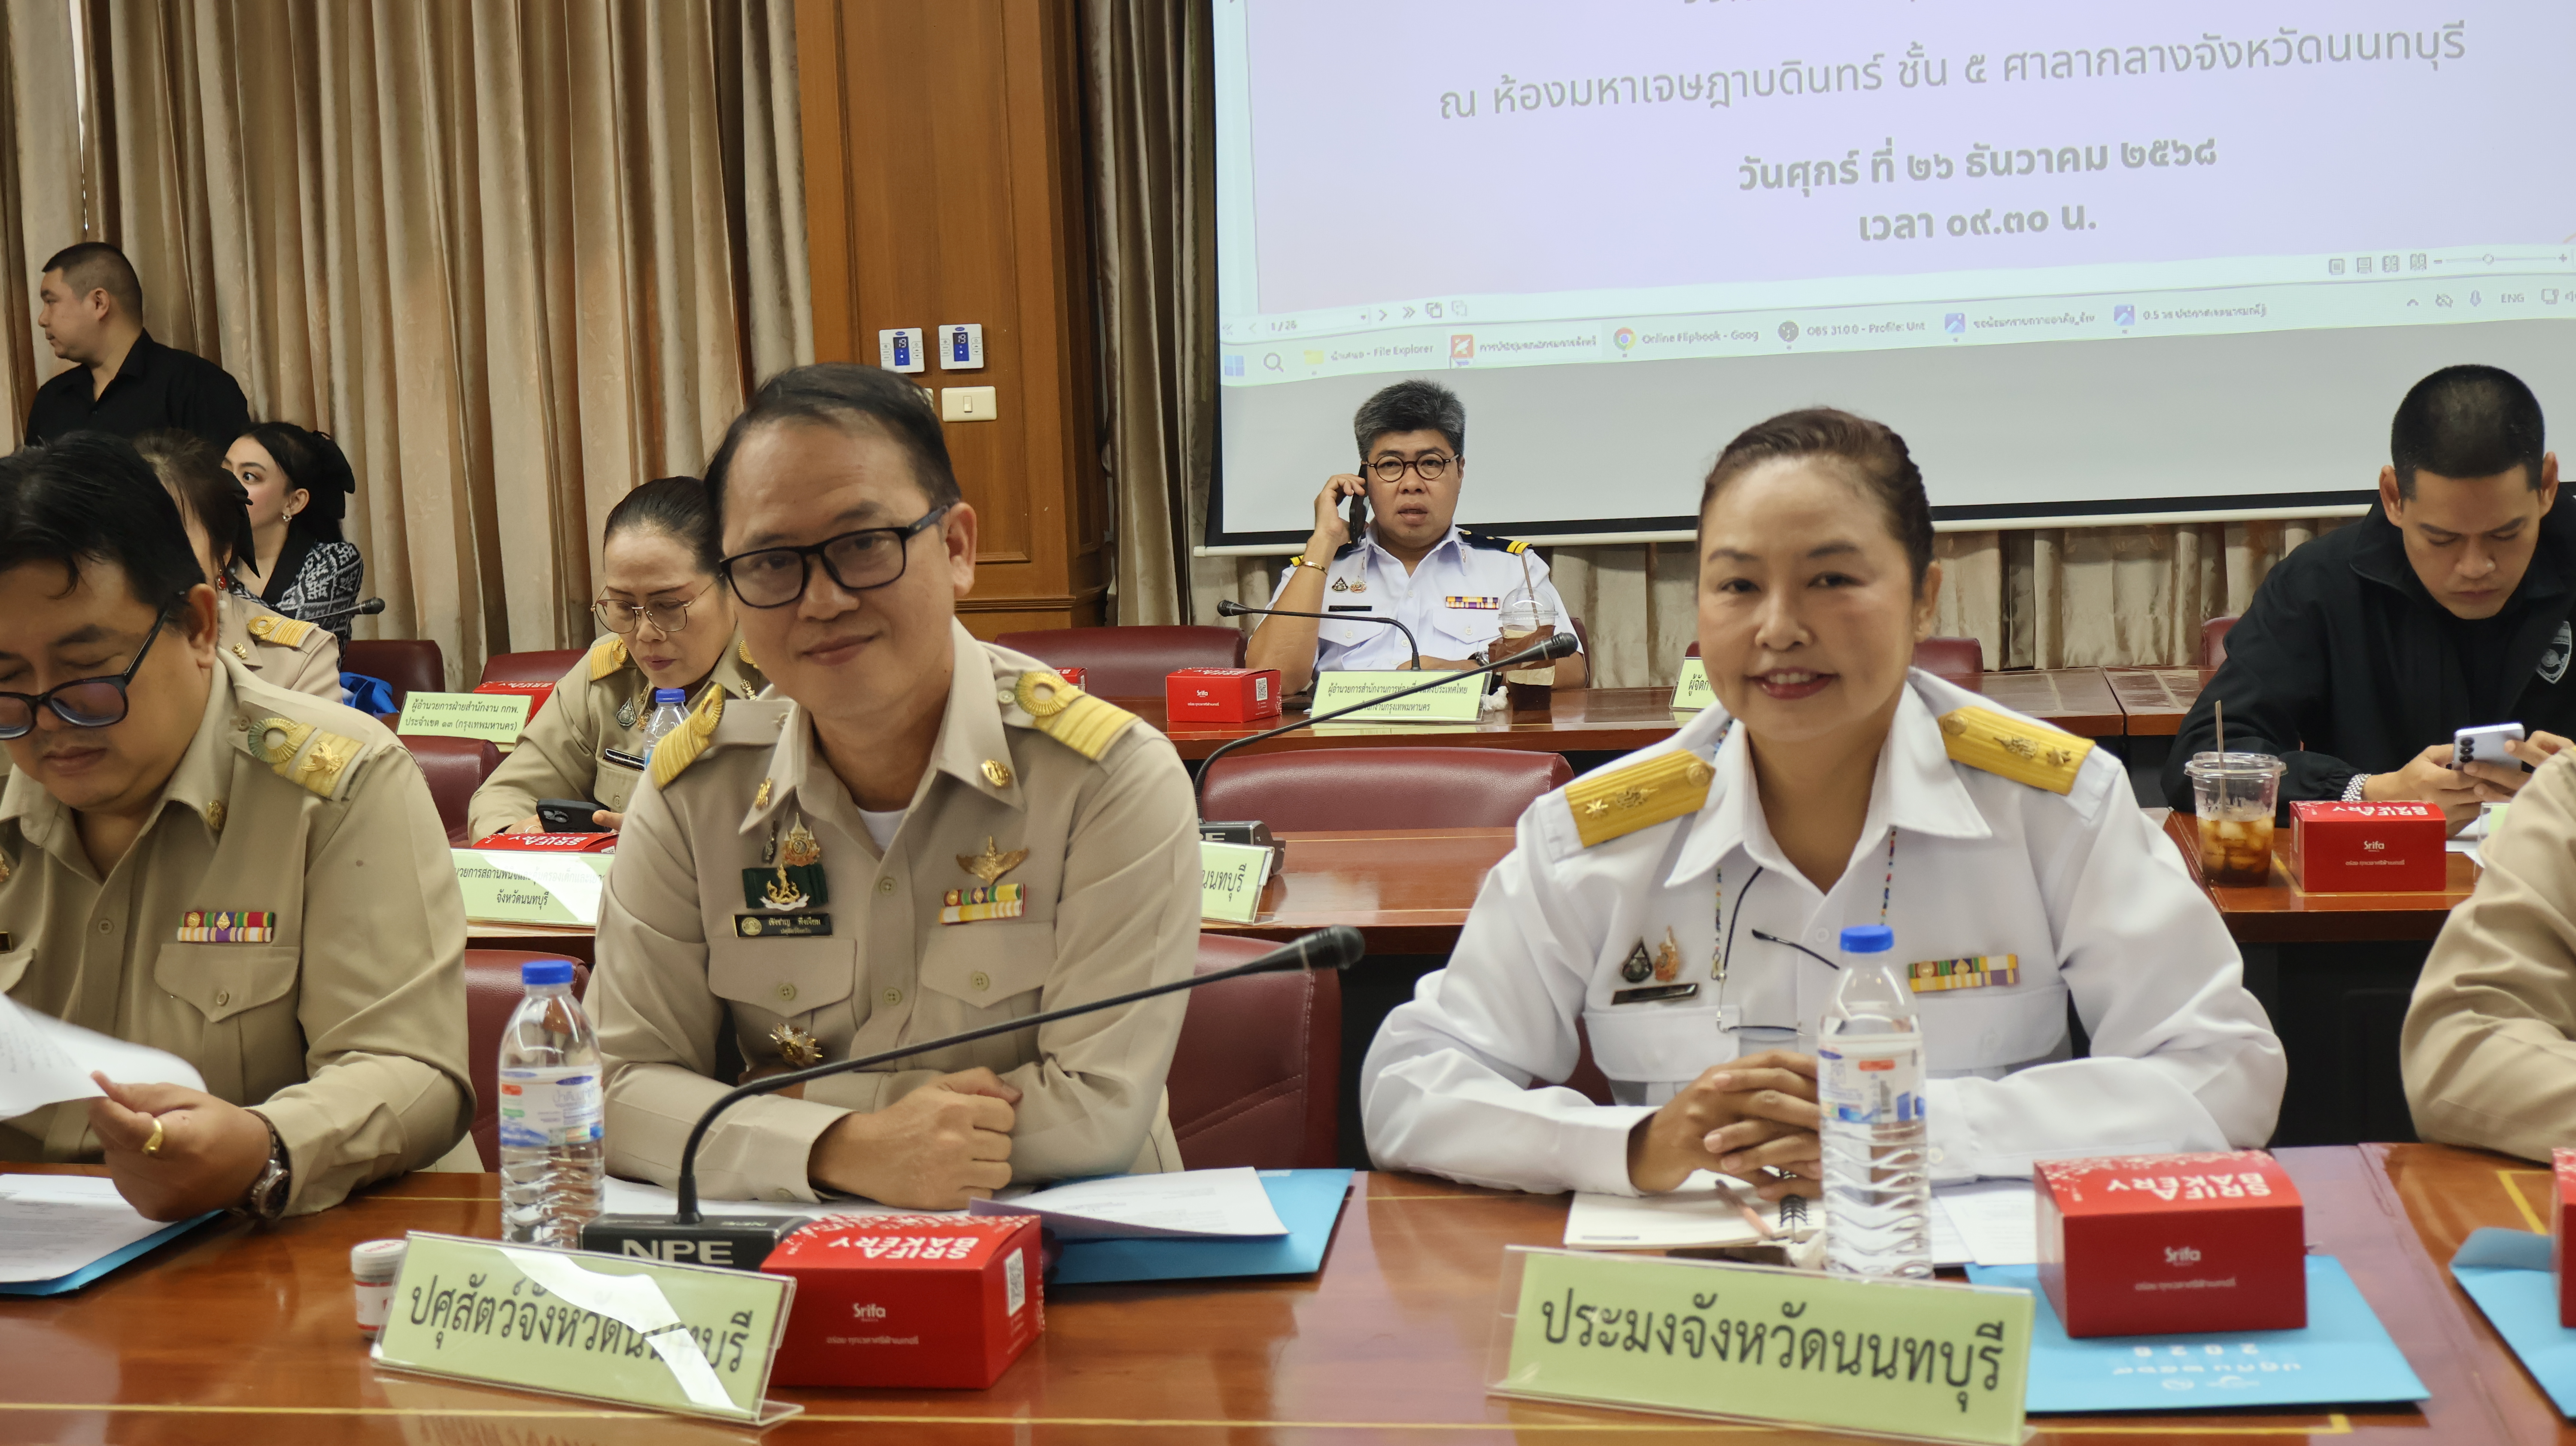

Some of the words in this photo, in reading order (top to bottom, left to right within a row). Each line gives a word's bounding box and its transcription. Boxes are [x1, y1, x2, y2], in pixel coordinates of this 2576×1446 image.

[1440, 90, 1476, 120] ณ
[1494, 53, 1885, 114] ห้องมหาเจษฎาบดินทร์
[1898, 41, 1947, 88] ชั้น
[1965, 54, 1987, 84] ๕
[2004, 19, 2466, 82] ศาลากลางจังหวัดนนทบุรี
[1738, 149, 1860, 198] วันศุกร์
[1871, 137, 1895, 183] ที่
[1907, 153, 1953, 182] ๒๖
[1965, 143, 2108, 178] ธันวาคม
[2120, 138, 2217, 169] ๒๕๖๘
[1859, 212, 1934, 242] เวลา
[1946, 208, 2049, 237] ๐๙.๓๐
[2061, 205, 2097, 231] น.
[2501, 292, 2525, 303] ENG
[898, 338, 907, 348] 19
[957, 334, 966, 344] 19
[1641, 332, 1675, 344] Online
[1677, 330, 1722, 344] Flipbook
[1731, 330, 1759, 342] Goog
[1373, 346, 1391, 357] File
[1393, 344, 1434, 358] Explorer
[412, 698, 498, 713] ผู้อำนวยการฝ่ายสำนักงาน
[405, 716, 439, 727] ประจำเขต
[456, 719, 517, 732] (กรุงเทพมหานคร)
[2363, 840, 2385, 850] Srifa
[496, 889, 549, 910] จังหวัดนนทบุรี
[2106, 1173, 2266, 1192] BAKERY
[2151, 1184, 2272, 1201] SRIFA
[827, 1236, 980, 1248] BAKERY
[621, 1239, 734, 1265] NPE
[863, 1246, 971, 1260] SRIFA
[2163, 1246, 2202, 1263] Srifa
[853, 1303, 886, 1318] Srifa
[1541, 1287, 2005, 1413] ประมงจังหวัดนนทบุรี
